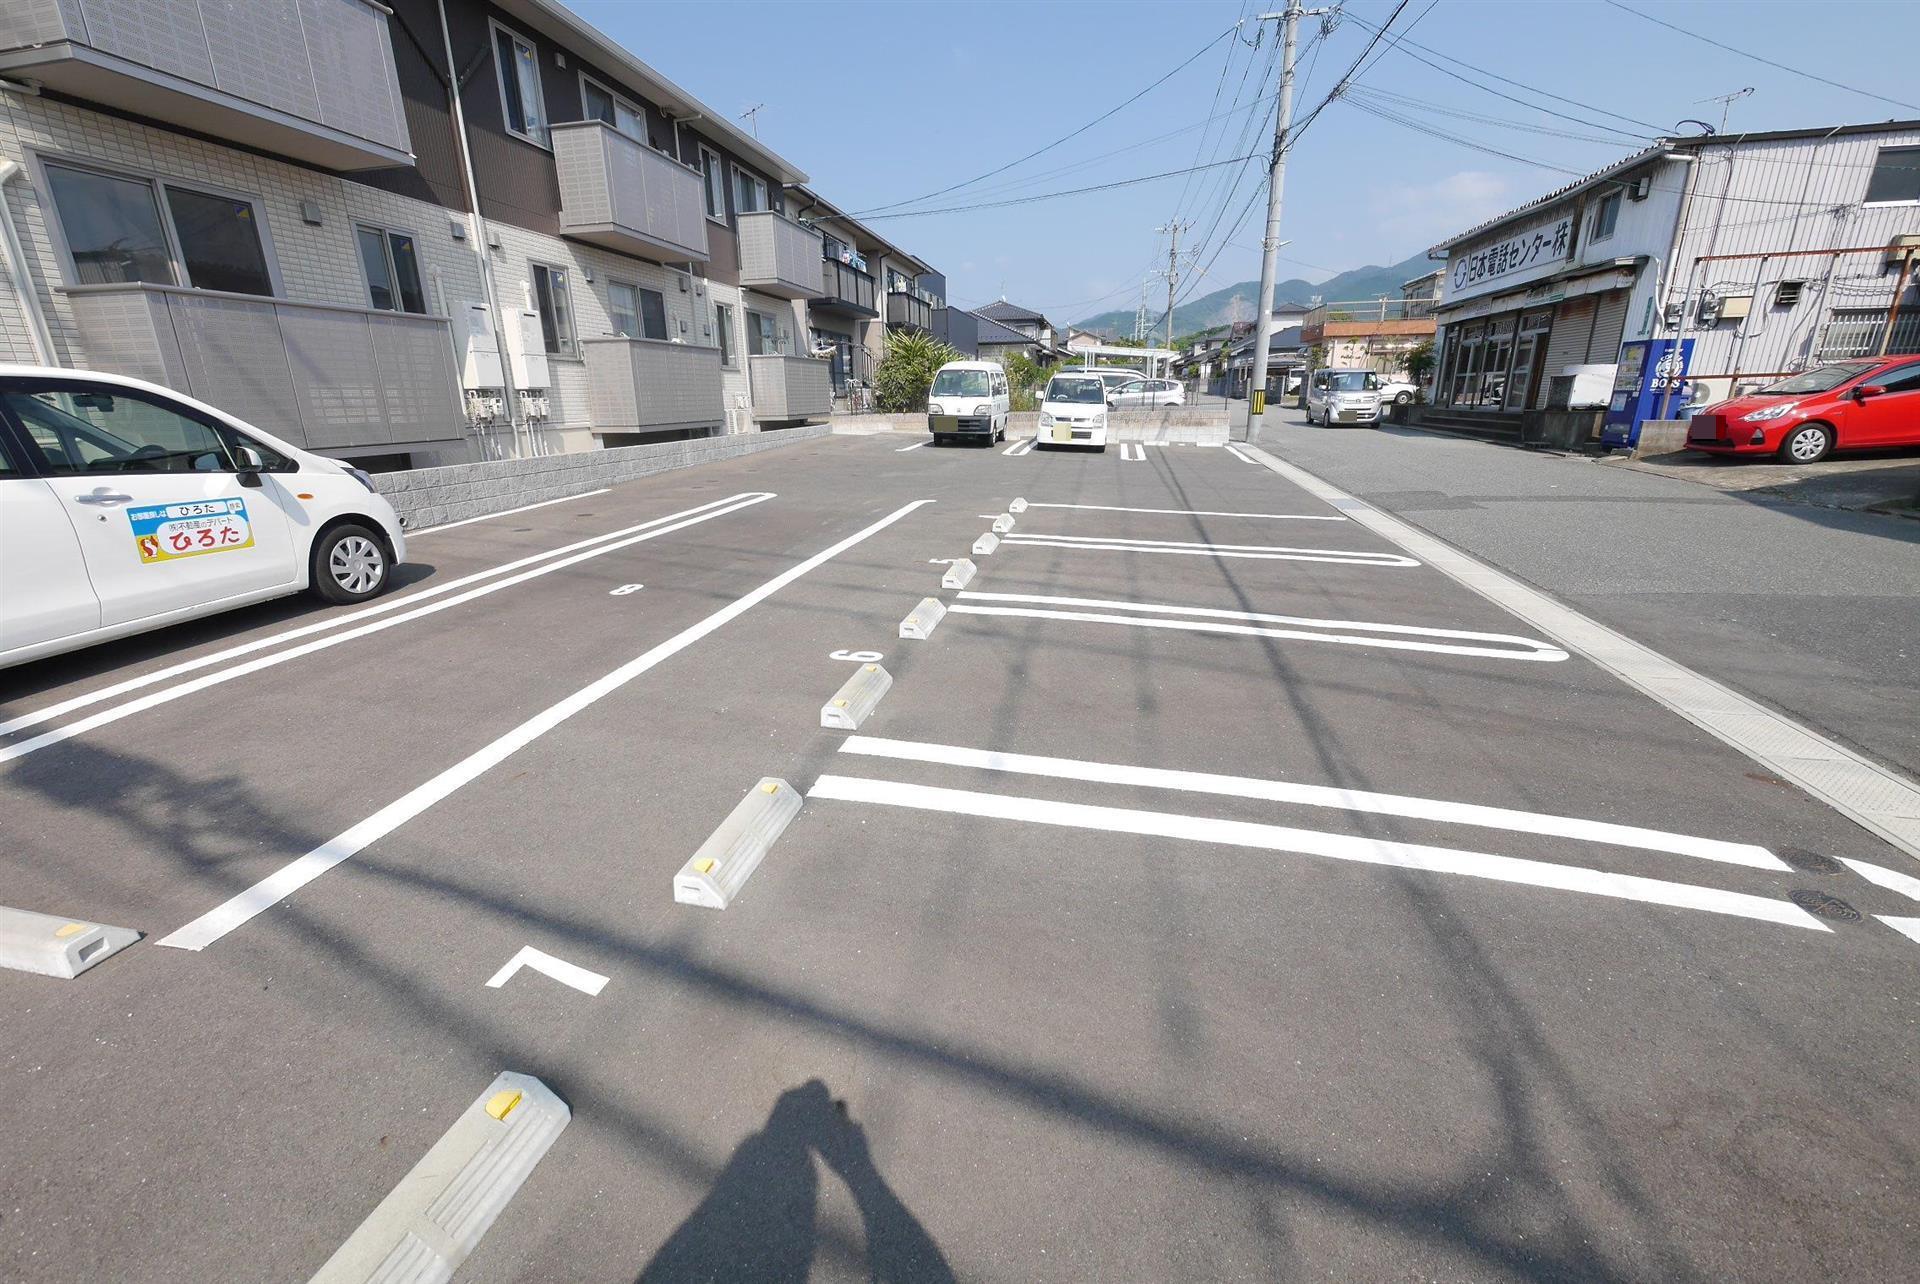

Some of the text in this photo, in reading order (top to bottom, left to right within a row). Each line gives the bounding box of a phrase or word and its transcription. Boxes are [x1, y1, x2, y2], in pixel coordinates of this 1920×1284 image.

[1650, 378, 1680, 388] BOS
[179, 503, 215, 516] ひろた
[169, 526, 241, 551] ひろた
